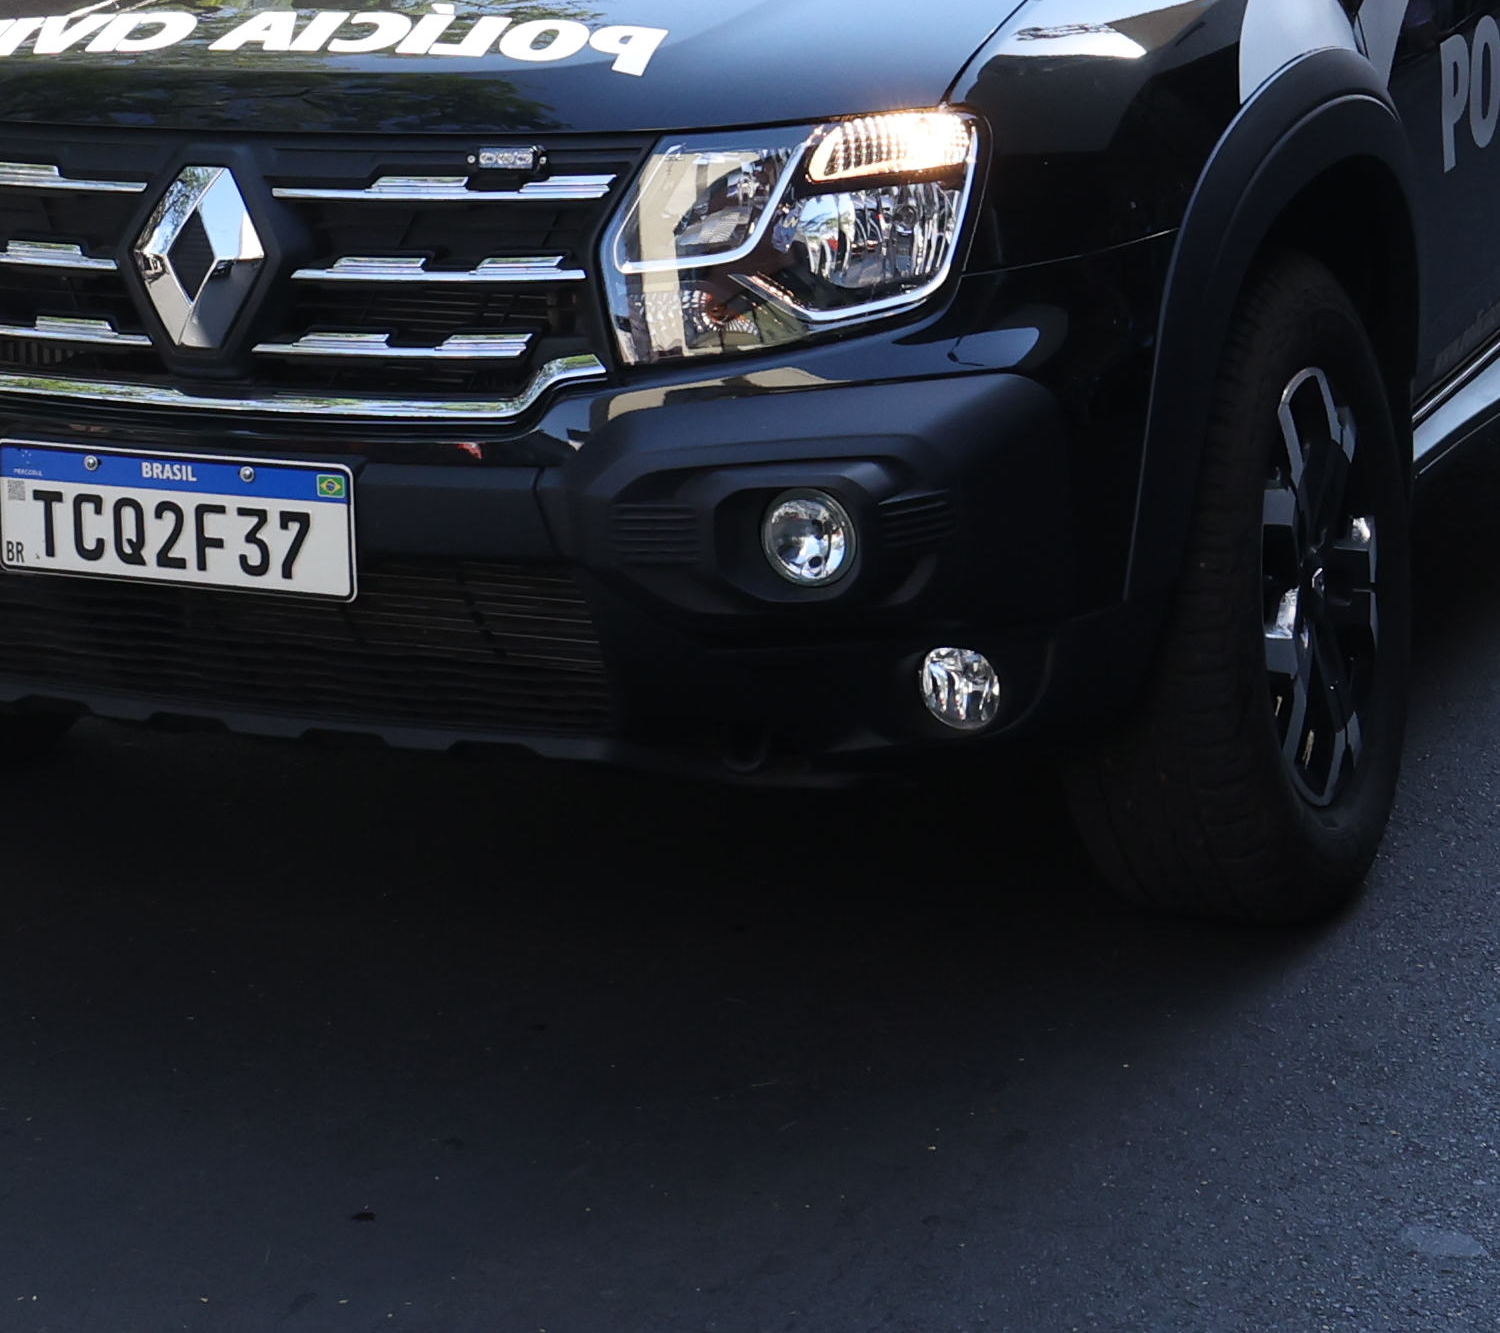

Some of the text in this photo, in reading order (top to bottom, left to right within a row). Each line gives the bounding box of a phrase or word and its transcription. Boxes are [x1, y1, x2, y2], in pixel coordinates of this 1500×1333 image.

[141, 461, 197, 482] BRASIL
[32, 489, 312, 580] TCQ2F37
[6, 540, 25, 564] BR
